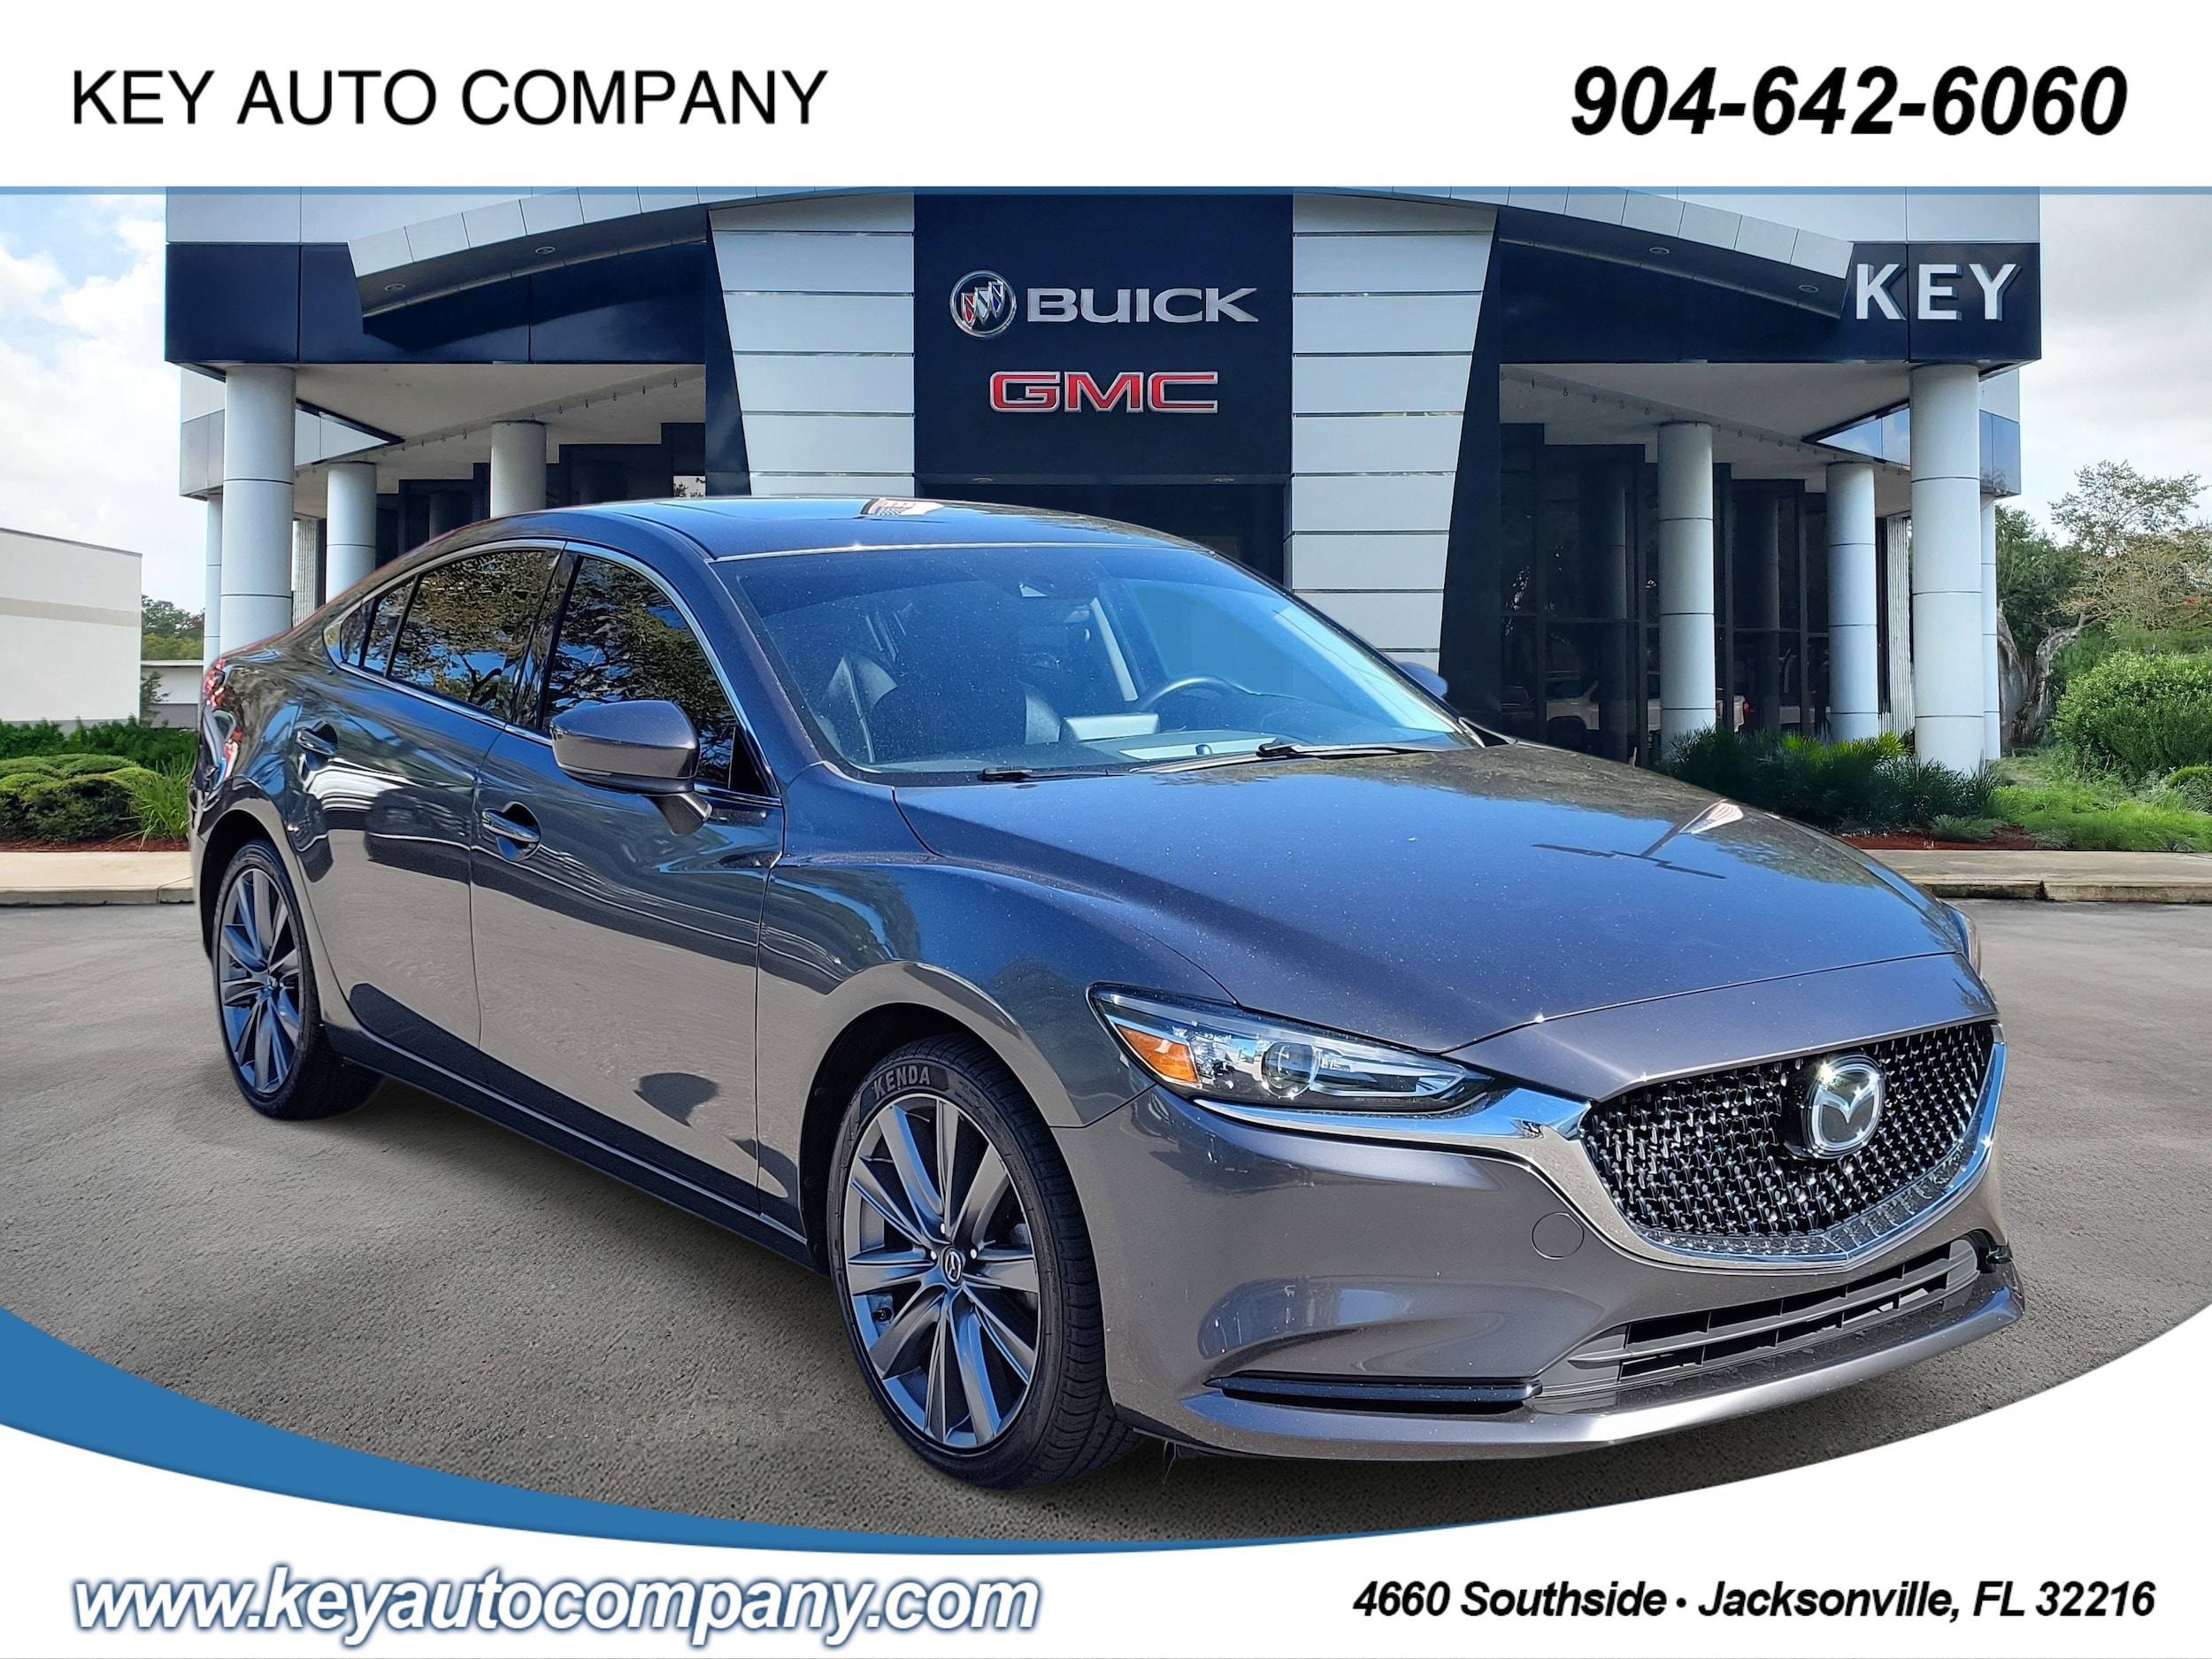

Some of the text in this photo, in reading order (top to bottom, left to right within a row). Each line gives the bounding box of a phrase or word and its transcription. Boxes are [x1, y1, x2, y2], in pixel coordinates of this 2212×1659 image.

[1026, 288, 1258, 323] BUICK
[1855, 263, 2021, 321] KEY
[989, 371, 1218, 413] GMC
[873, 1064, 930, 1100] KENDA
